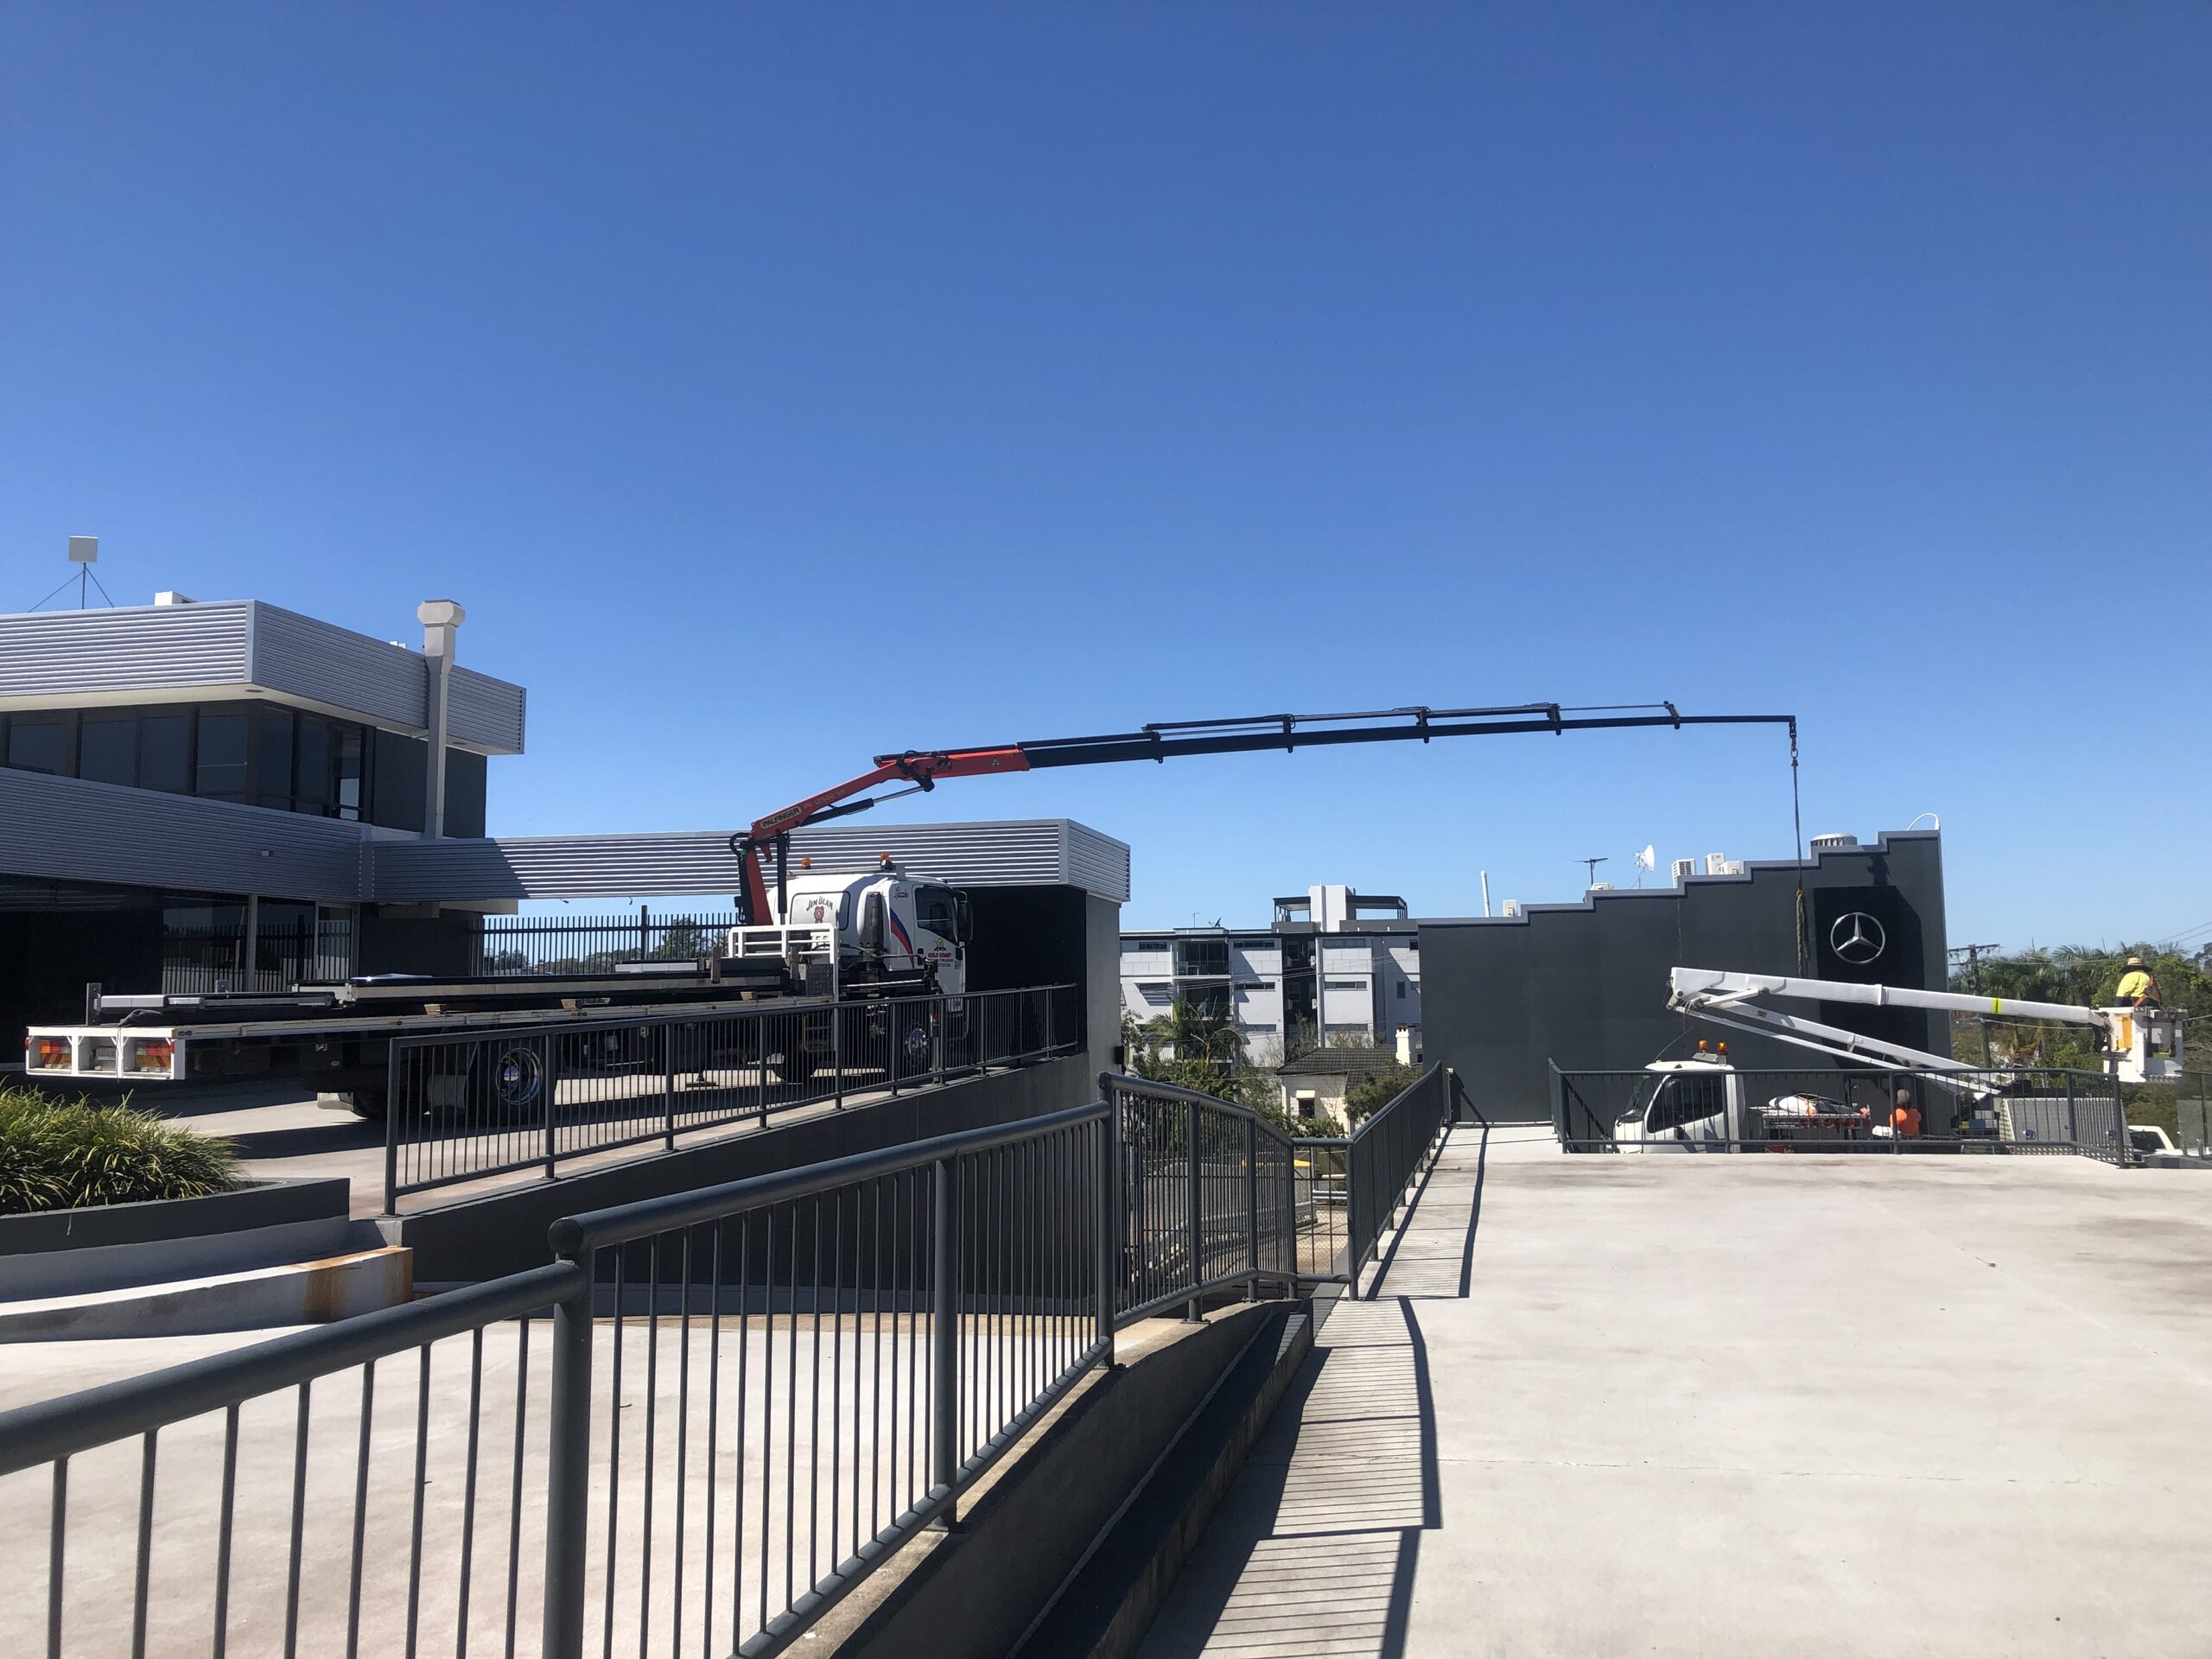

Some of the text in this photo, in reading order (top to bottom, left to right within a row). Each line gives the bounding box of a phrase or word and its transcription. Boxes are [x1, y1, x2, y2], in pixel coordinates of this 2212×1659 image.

[762, 807, 800, 827] PALFINGER
[806, 896, 833, 912] JIM BEAM
